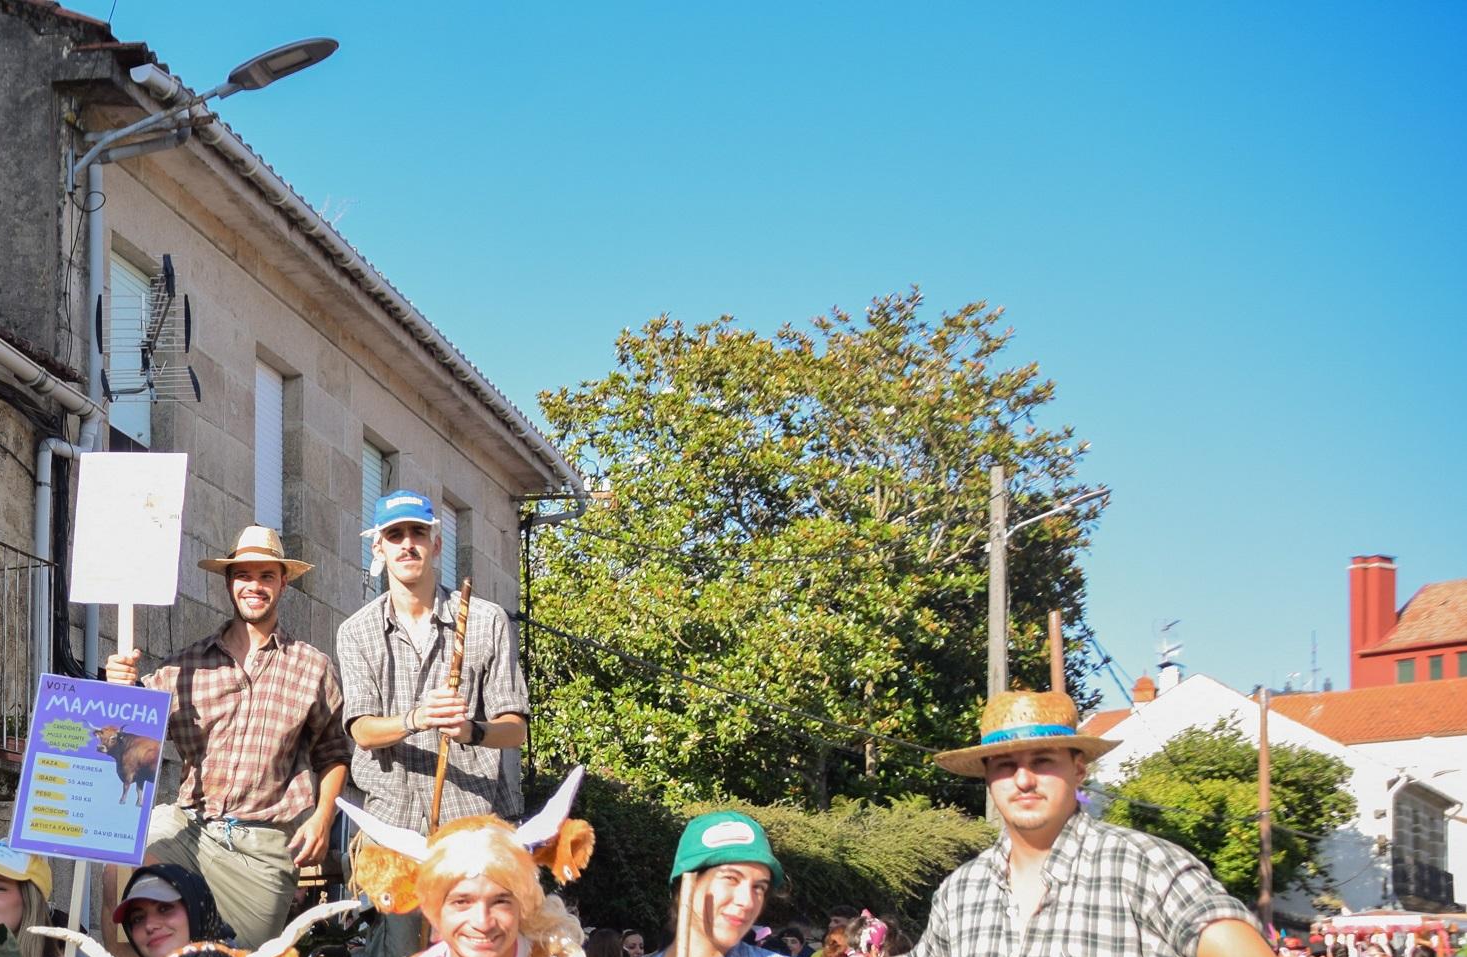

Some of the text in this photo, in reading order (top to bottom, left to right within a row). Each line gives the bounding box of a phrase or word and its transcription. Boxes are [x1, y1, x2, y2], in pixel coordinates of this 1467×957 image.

[46, 681, 76, 693] VOTA
[45, 694, 158, 725] MAMUCHA
[53, 723, 82, 732] CANDIDATA
[30, 821, 56, 830] ARTISTA
[57, 824, 88, 834] FAVORITO
[94, 829, 112, 837] DAVID
